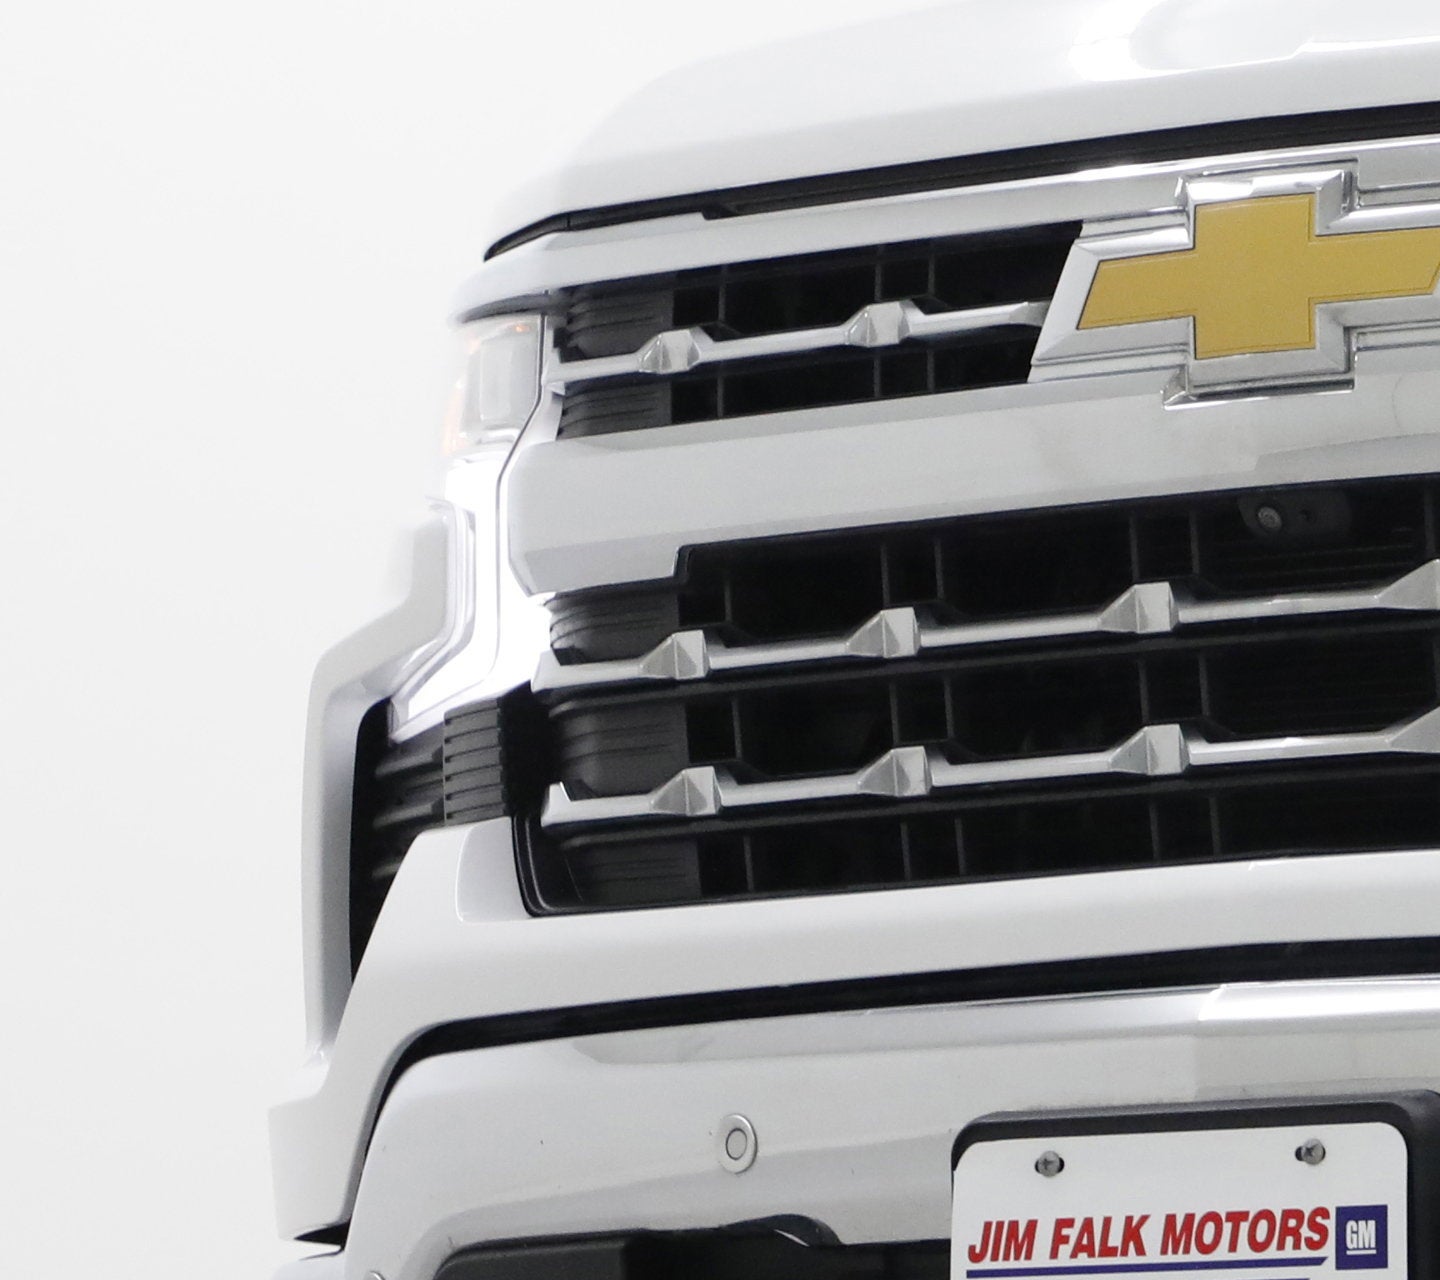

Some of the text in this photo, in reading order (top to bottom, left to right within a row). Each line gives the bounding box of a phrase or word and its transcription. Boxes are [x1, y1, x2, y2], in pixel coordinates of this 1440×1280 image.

[967, 1206, 1330, 1264] JIM FALK MOTORS
[1345, 1219, 1377, 1250] GM
